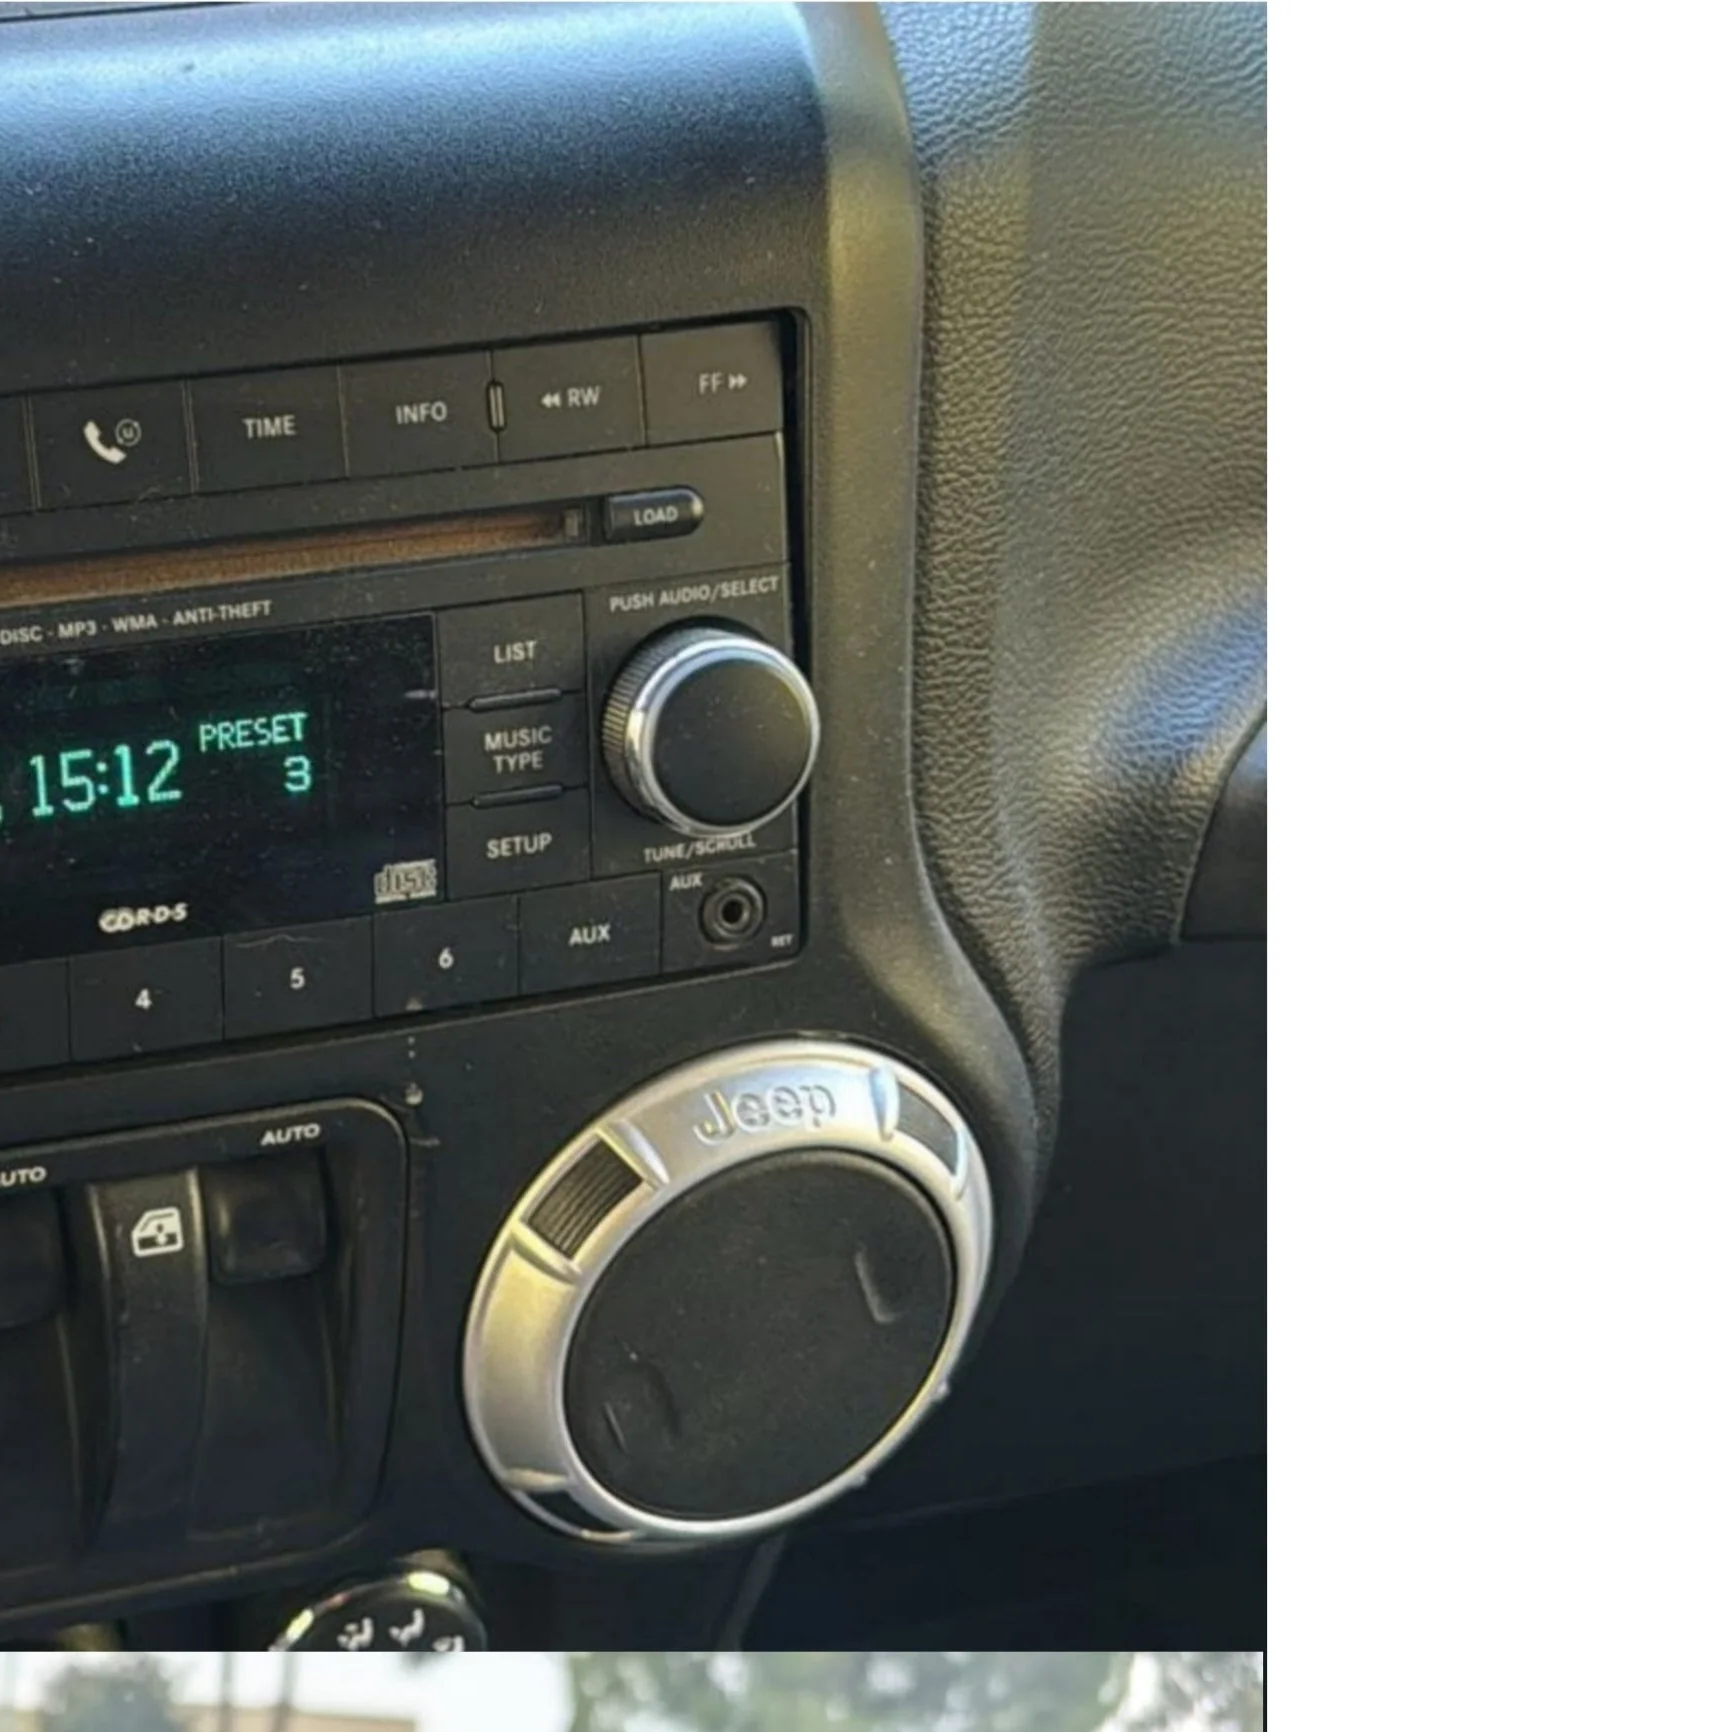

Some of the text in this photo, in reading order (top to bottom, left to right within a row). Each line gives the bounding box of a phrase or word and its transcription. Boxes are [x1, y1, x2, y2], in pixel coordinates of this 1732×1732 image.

[698, 372, 724, 394] FF
[567, 386, 602, 409] RW
[396, 401, 448, 426] INFO
[243, 415, 297, 440] TIME
[633, 505, 679, 526] LOAD
[609, 576, 781, 612] PUSH AUDIO/SELECT
[0, 624, 43, 646] DISC
[58, 618, 98, 638] MP3
[112, 613, 158, 632] WMA
[173, 601, 273, 627] ANTI-THEFT
[493, 640, 538, 664] LIST
[199, 711, 308, 753] PRESET
[483, 724, 553, 752] MUSIC
[493, 748, 544, 773] TYPE
[29, 739, 183, 818] 15:12
[283, 755, 312, 793] 3
[486, 832, 553, 859] SETUP
[643, 833, 757, 864] TUNE/SCROLL
[669, 873, 704, 892] AUX
[568, 923, 611, 946] AUX
[438, 948, 454, 969] 6
[289, 968, 305, 990] 5
[135, 988, 152, 1010] 4
[692, 1083, 836, 1146] Jeep
[259, 1122, 321, 1147] AUTO
